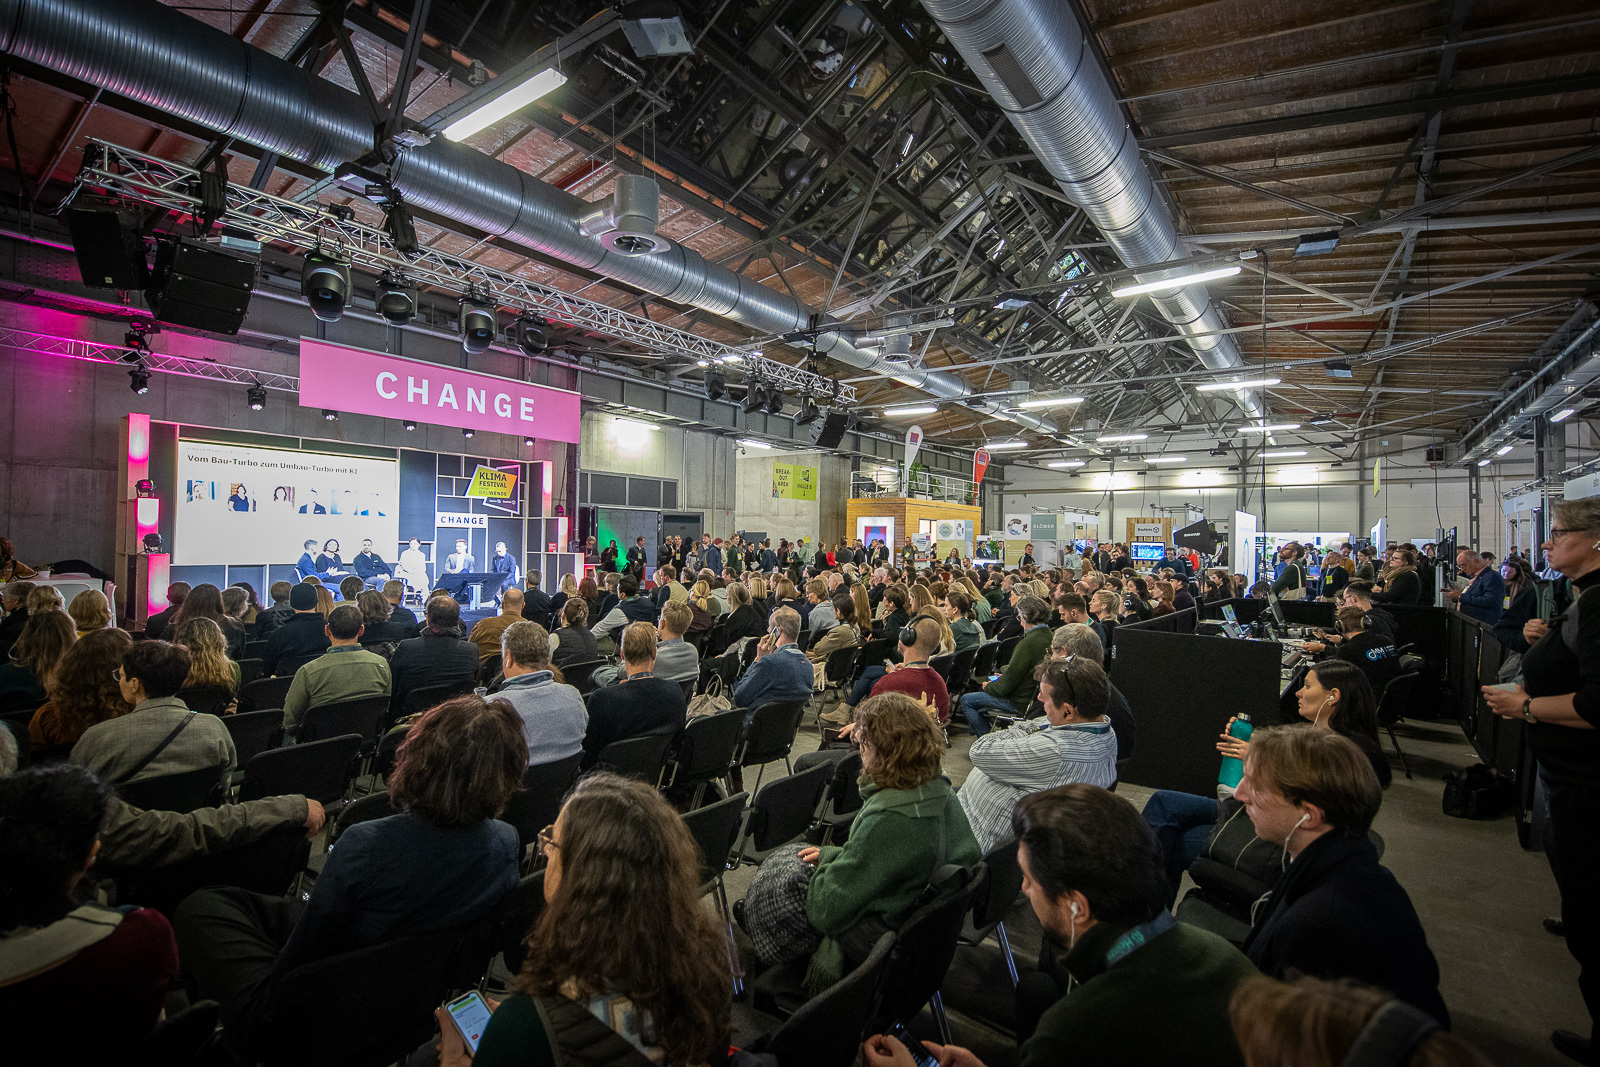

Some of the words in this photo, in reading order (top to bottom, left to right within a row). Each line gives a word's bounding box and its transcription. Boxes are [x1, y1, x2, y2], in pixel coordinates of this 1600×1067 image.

[375, 371, 535, 421] CHANGE
[187, 455, 209, 463] Vom
[211, 456, 258, 467] Bau-Turbo
[280, 462, 334, 473] Umbau-Turbo
[479, 472, 507, 482] KLIMA
[440, 516, 484, 525] CHANGE
